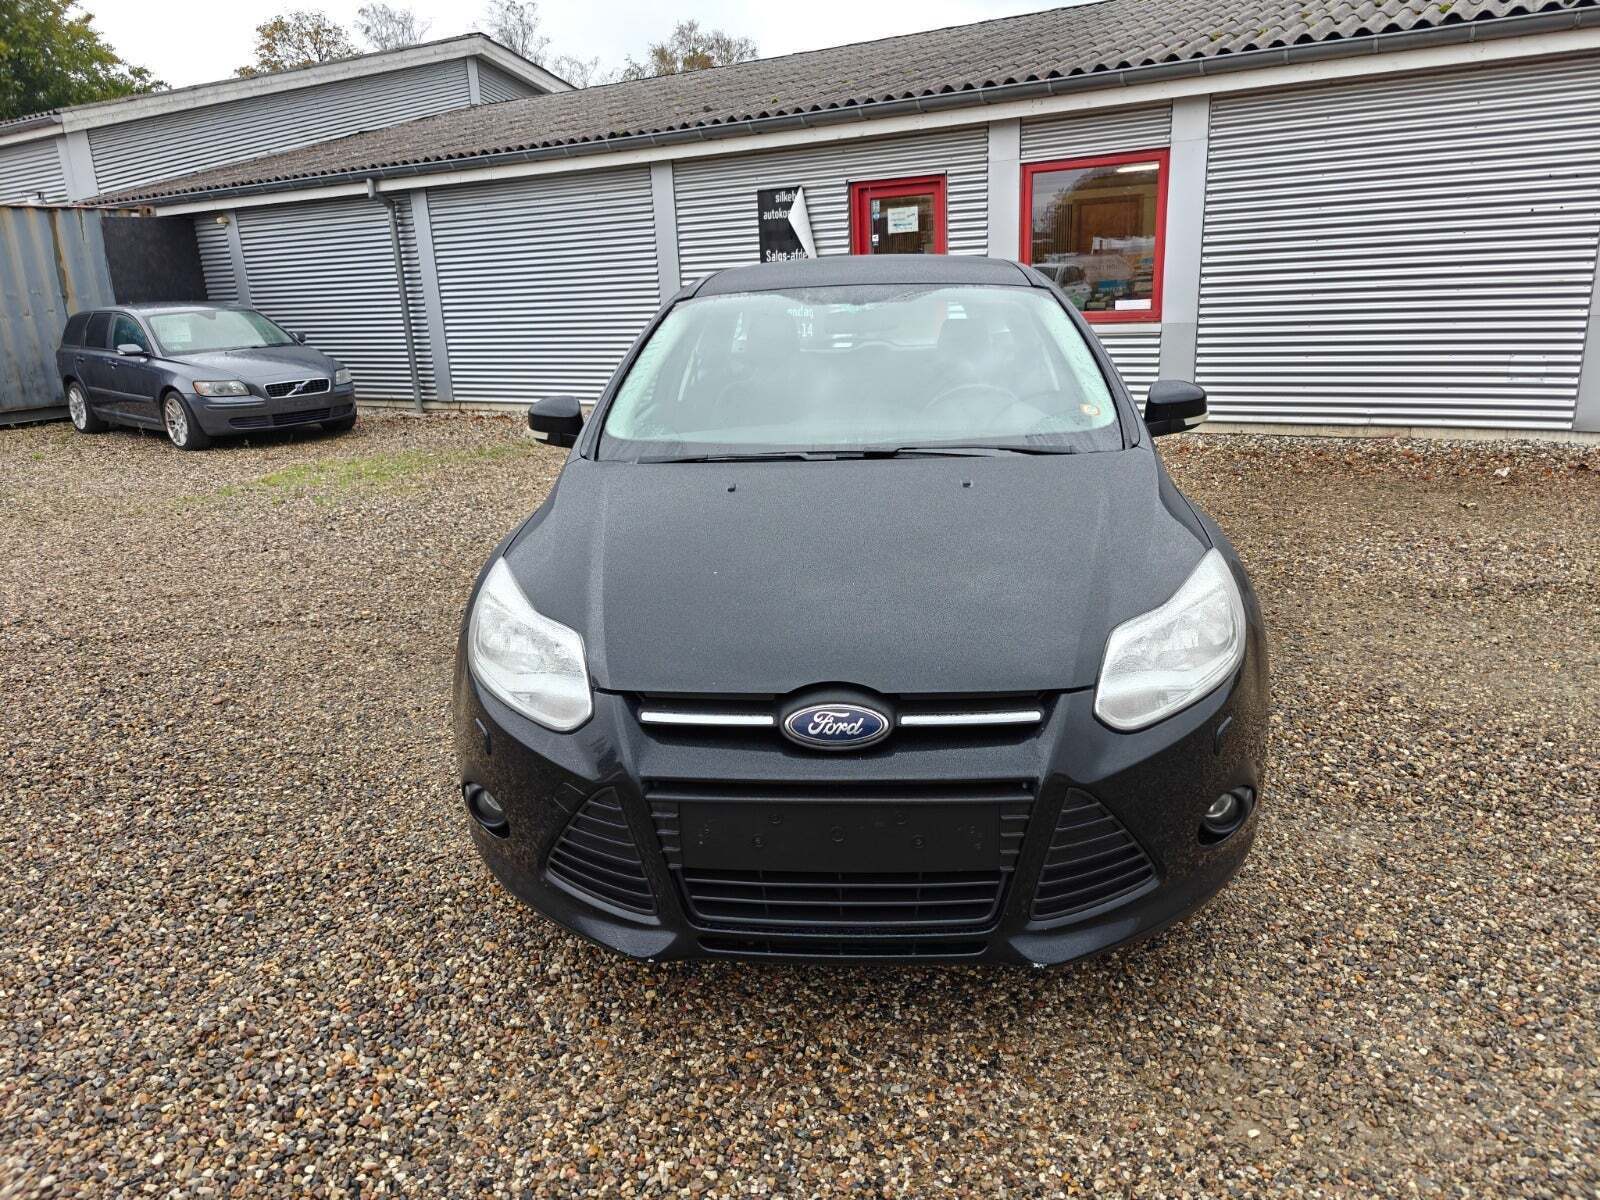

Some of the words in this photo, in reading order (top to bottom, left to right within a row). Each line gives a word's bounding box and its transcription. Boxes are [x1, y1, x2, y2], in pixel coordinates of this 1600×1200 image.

[775, 190, 797, 203] silkeb
[766, 248, 808, 262] Salgs-afde
[807, 711, 864, 735] Ford
